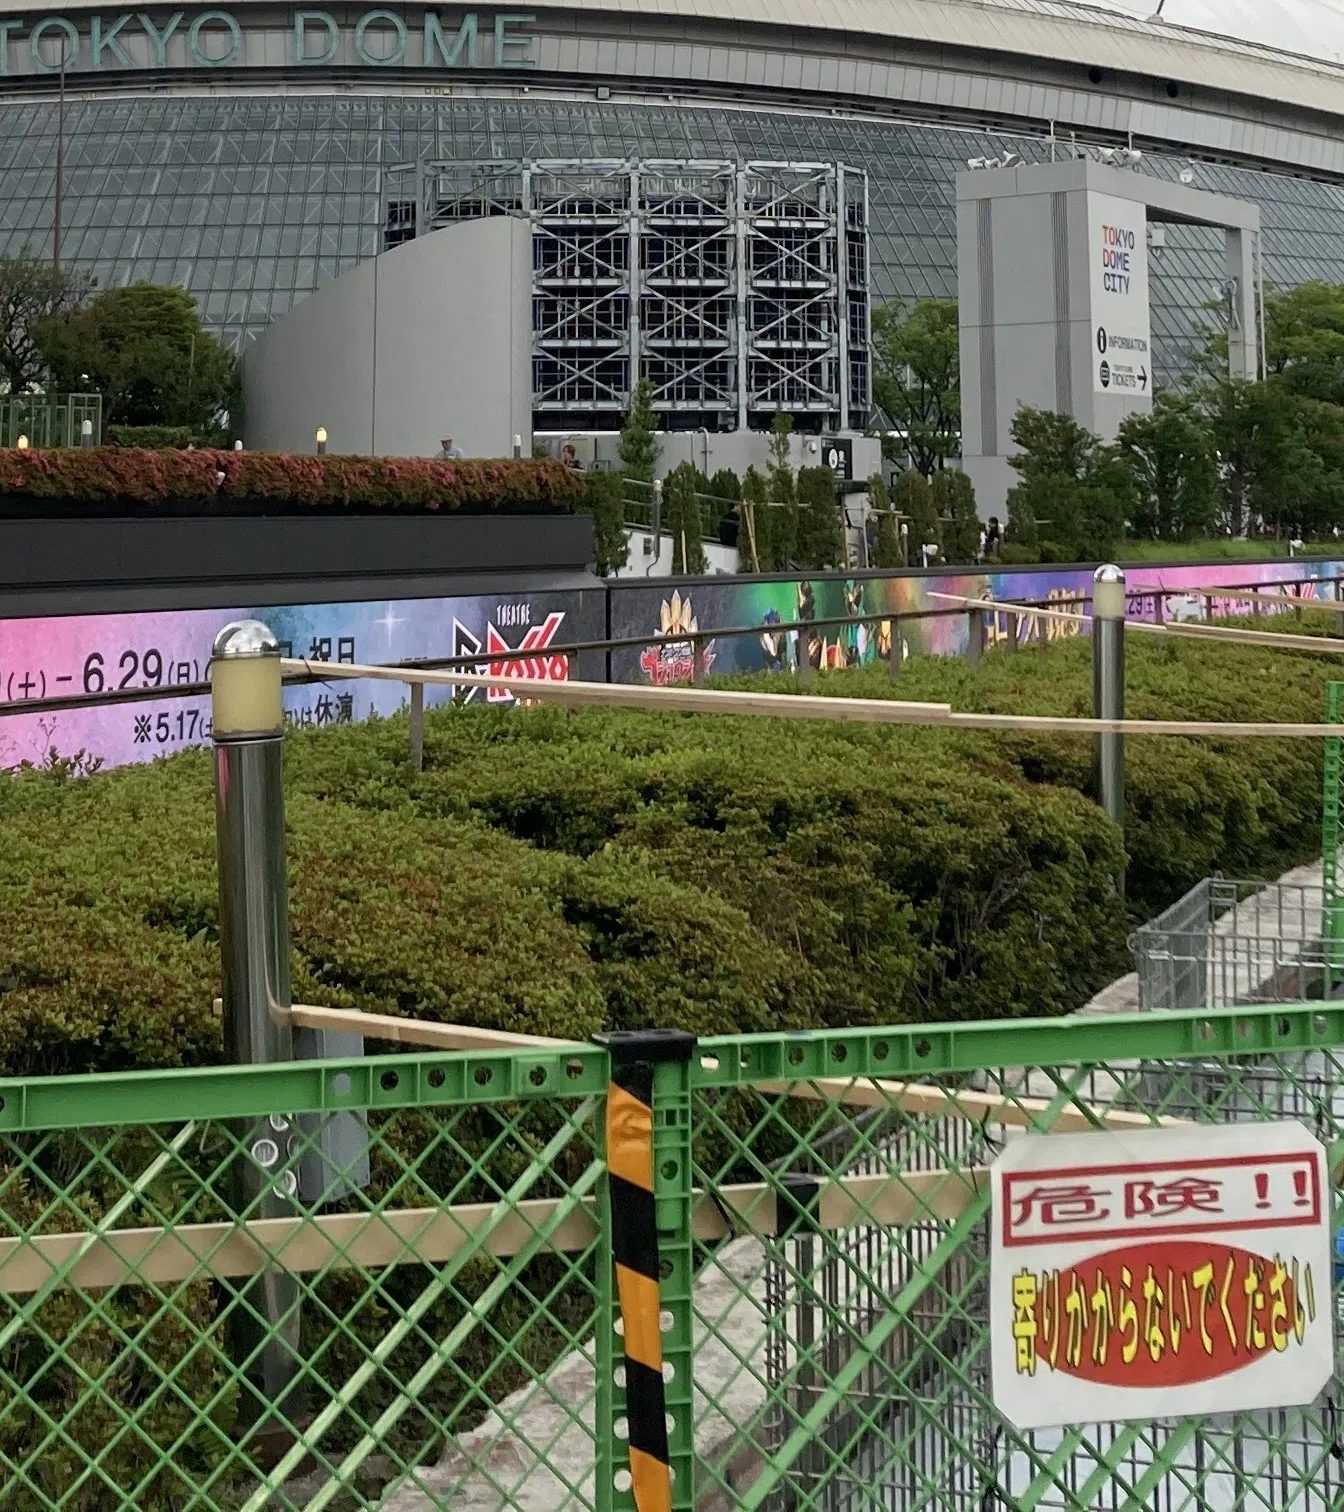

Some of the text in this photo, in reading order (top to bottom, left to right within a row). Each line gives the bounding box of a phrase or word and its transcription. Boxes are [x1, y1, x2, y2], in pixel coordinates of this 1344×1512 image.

[293, 7, 537, 69] DOME
[1102, 223, 1135, 250] TOKYO
[1102, 248, 1130, 272] DOME
[1103, 272, 1130, 295] CITY
[496, 603, 531, 626] THEATRE
[1011, 1250, 1316, 1377] 寄りかからないでください
